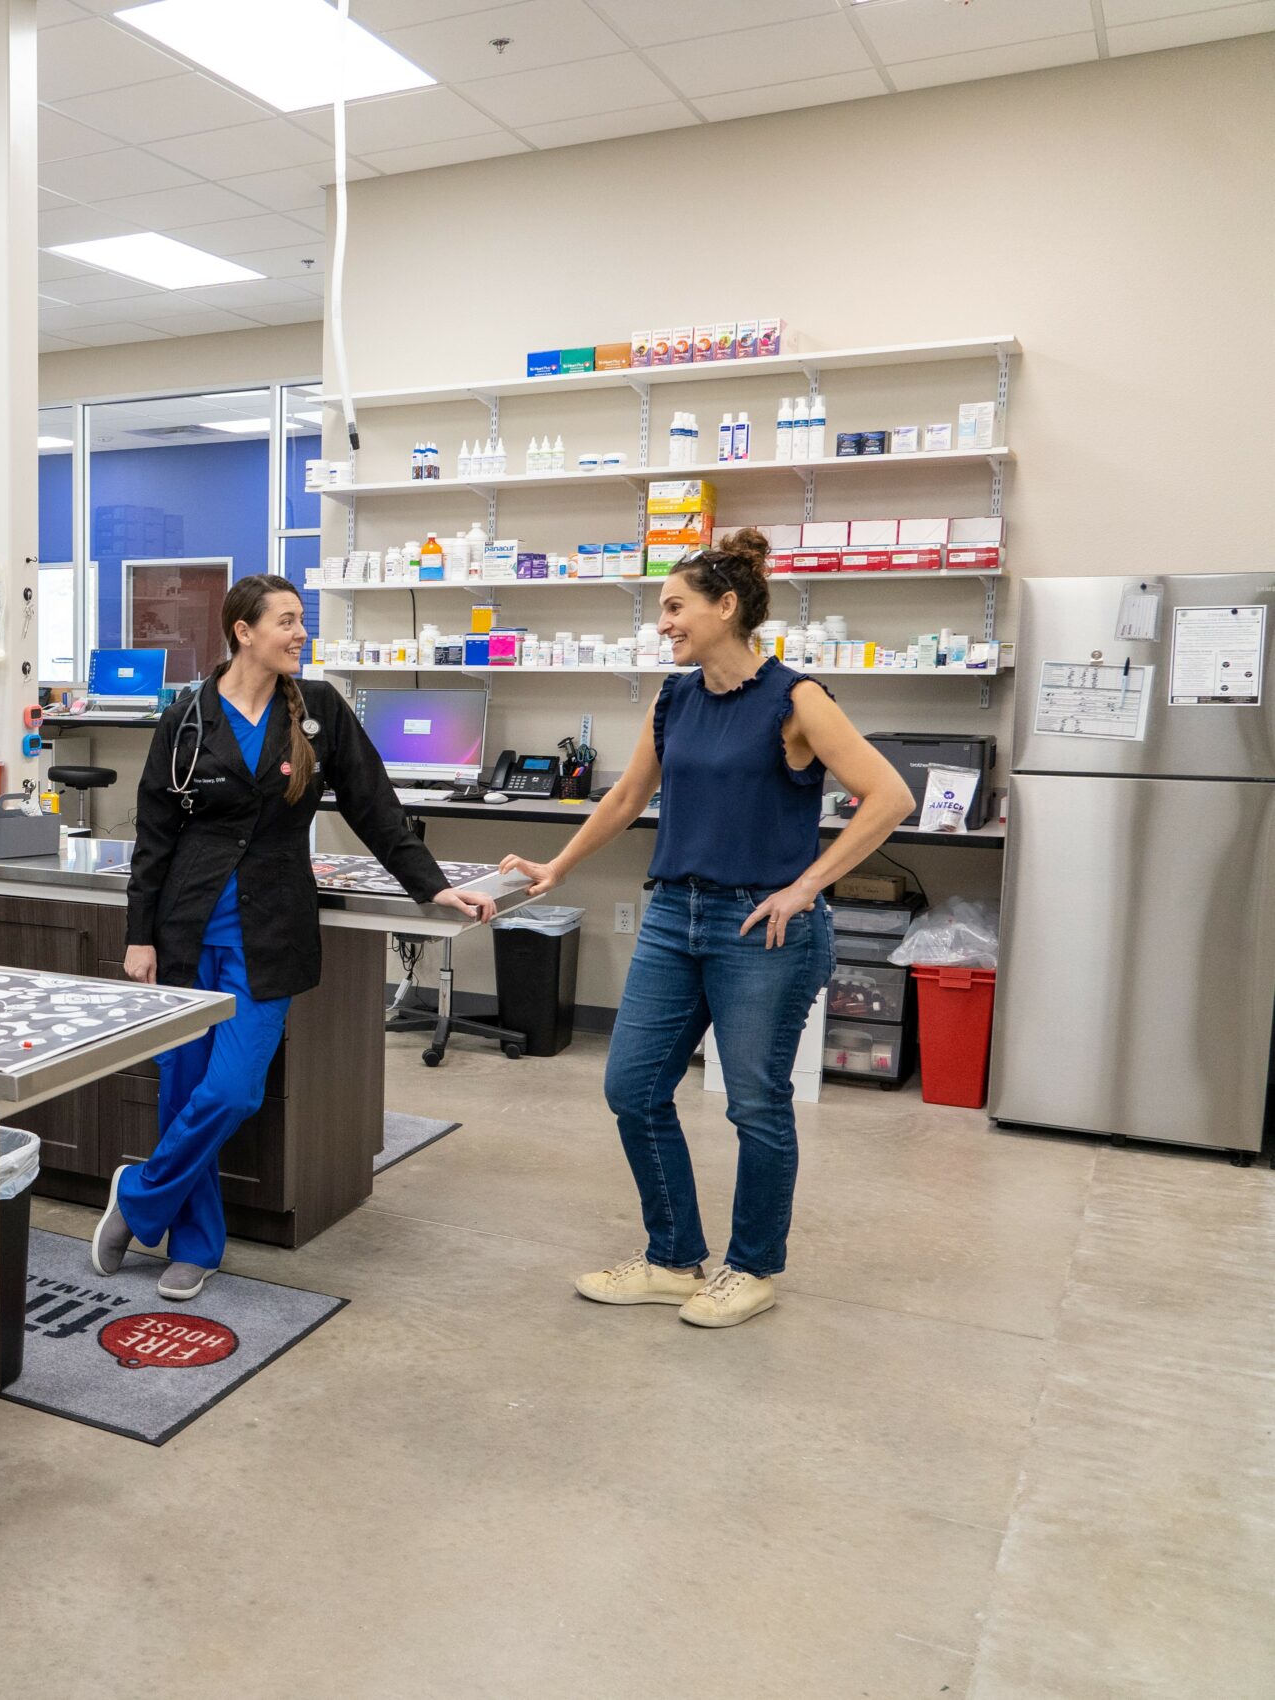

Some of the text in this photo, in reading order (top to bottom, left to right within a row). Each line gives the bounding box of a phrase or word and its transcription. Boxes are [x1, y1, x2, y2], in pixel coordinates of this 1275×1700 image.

[484, 545, 516, 554] panacur
[929, 801, 964, 811] ANTECH
[135, 1317, 226, 1349] HOUSE
[117, 1331, 200, 1361] FIRE
